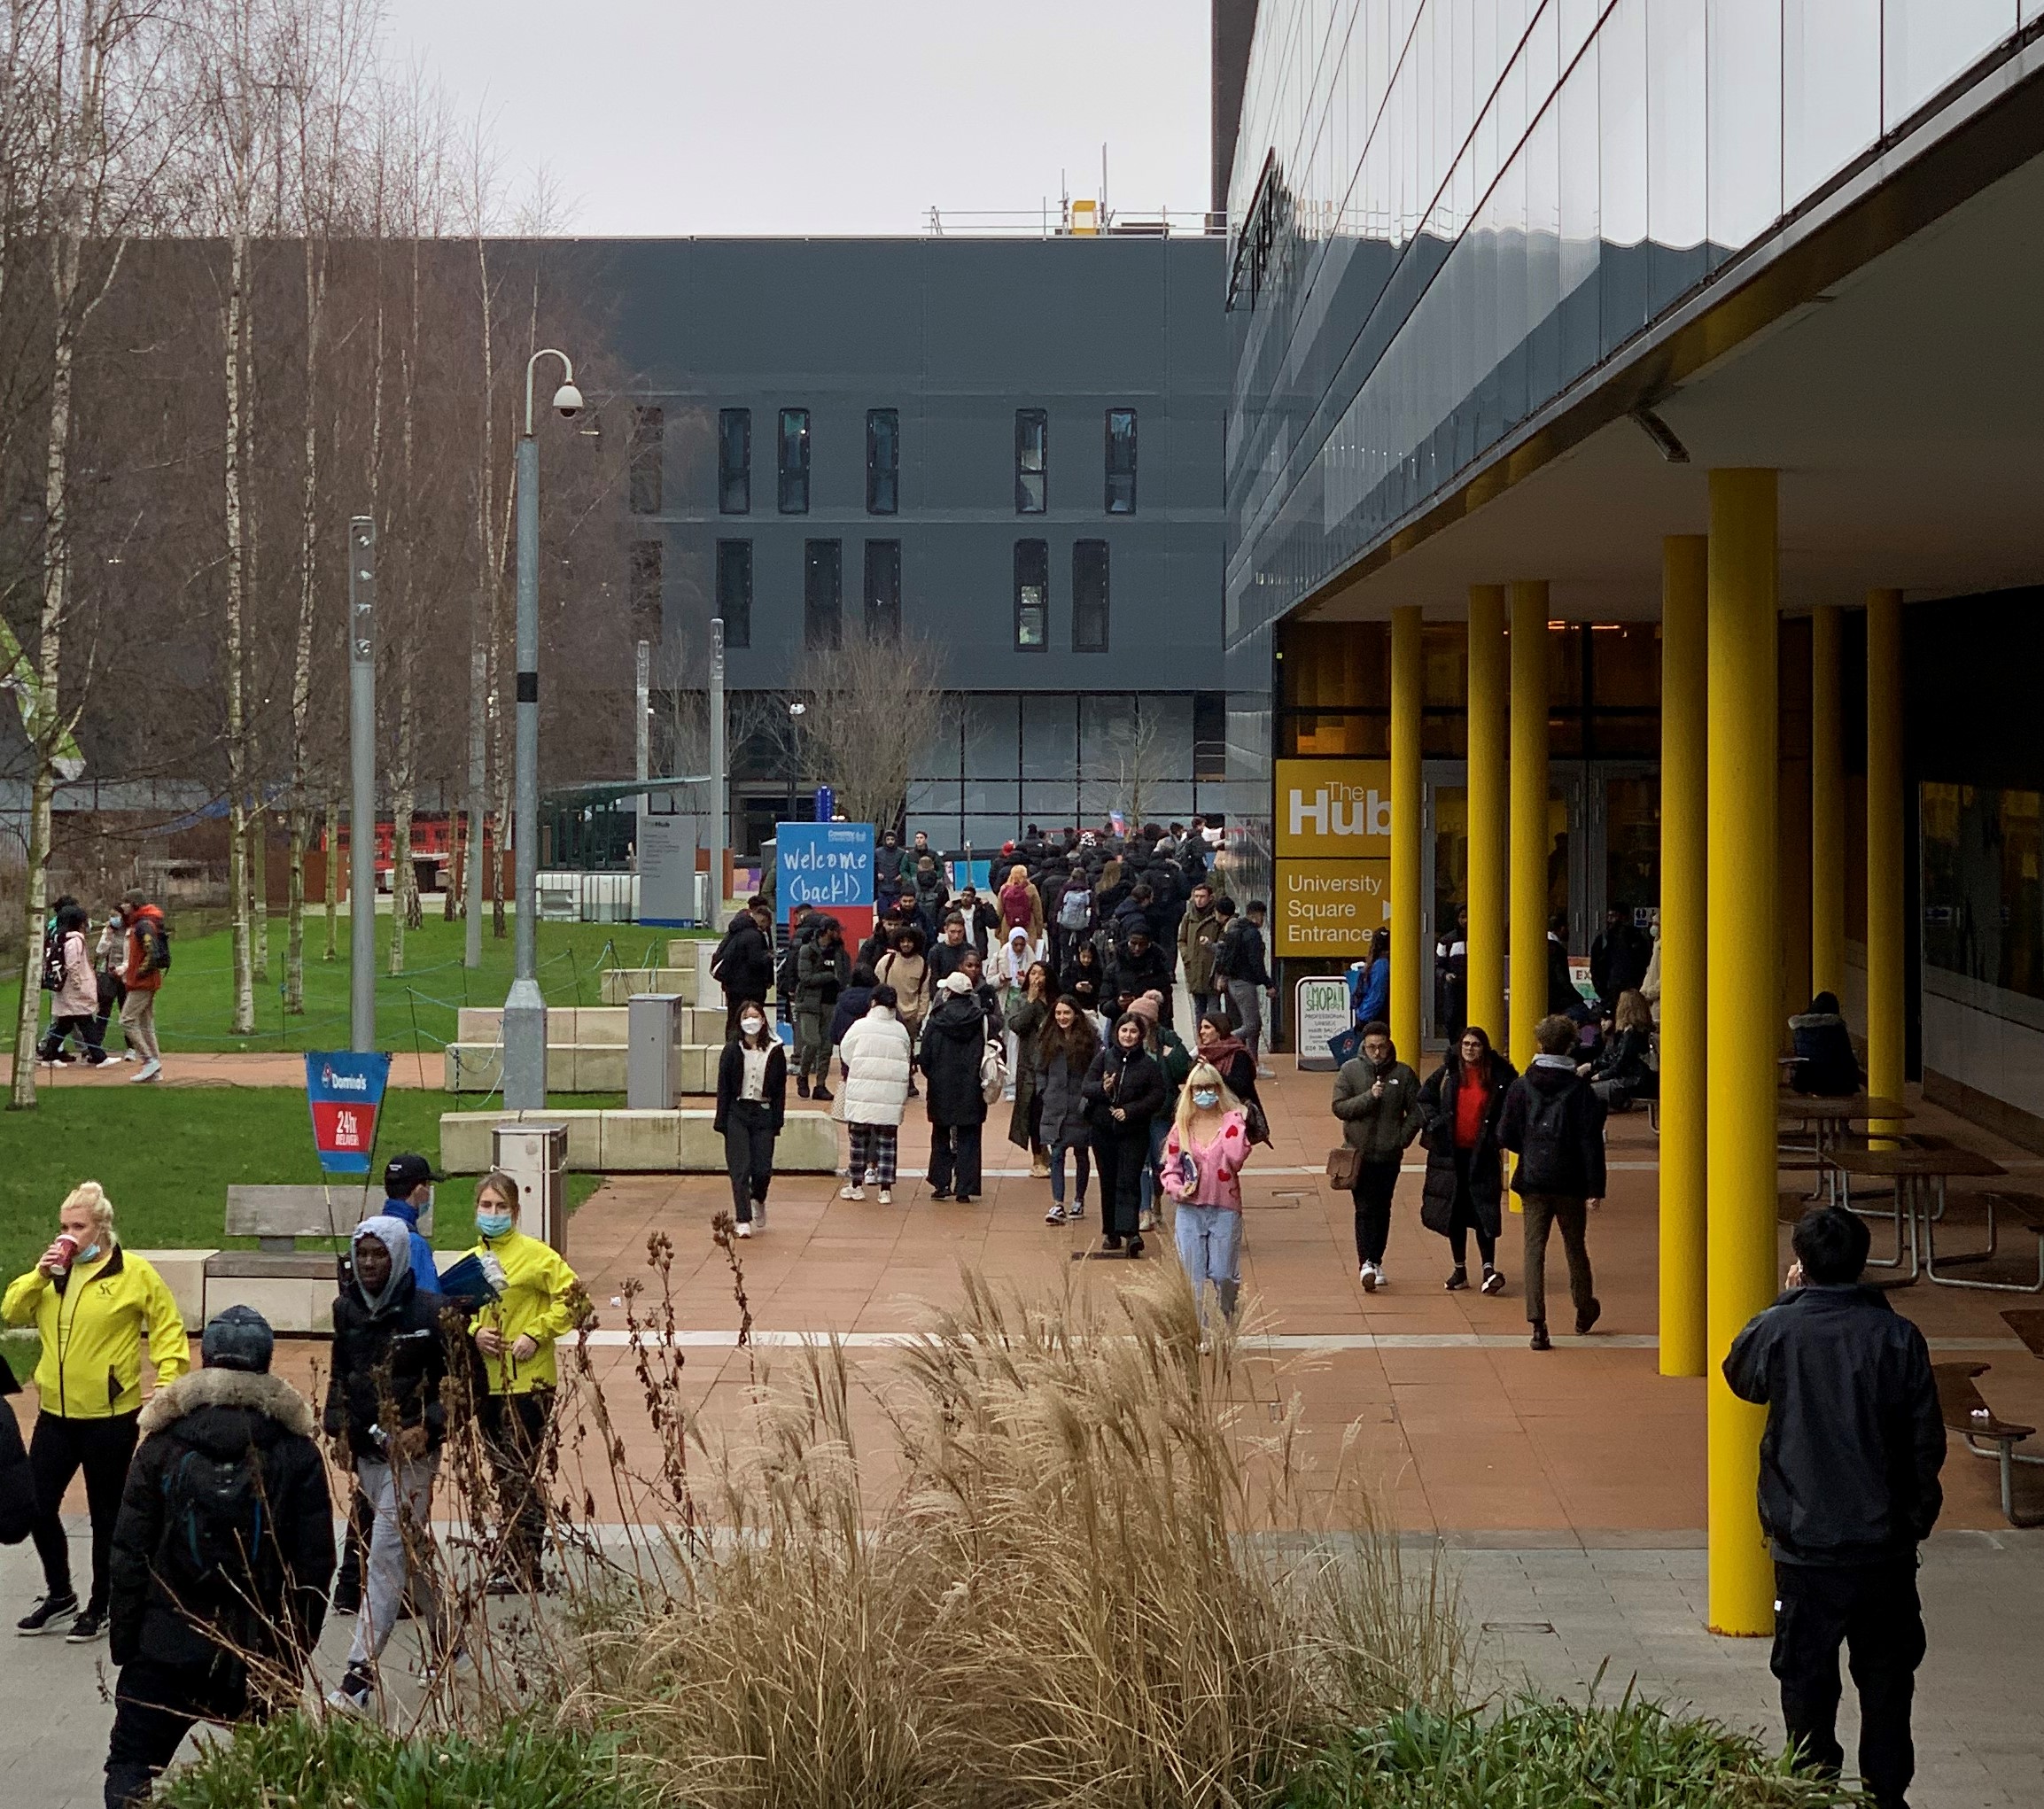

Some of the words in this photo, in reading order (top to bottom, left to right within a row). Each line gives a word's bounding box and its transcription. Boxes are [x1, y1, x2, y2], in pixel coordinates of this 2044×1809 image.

[1325, 781, 1364, 801] The
[1289, 789, 1391, 835] Hub
[789, 872, 860, 903] (back!)
[1288, 874, 1382, 896] University
[1287, 899, 1356, 920] Square
[1288, 925, 1373, 942] Entrance
[331, 1073, 367, 1091] Domino's
[337, 1110, 357, 1133] 24hr
